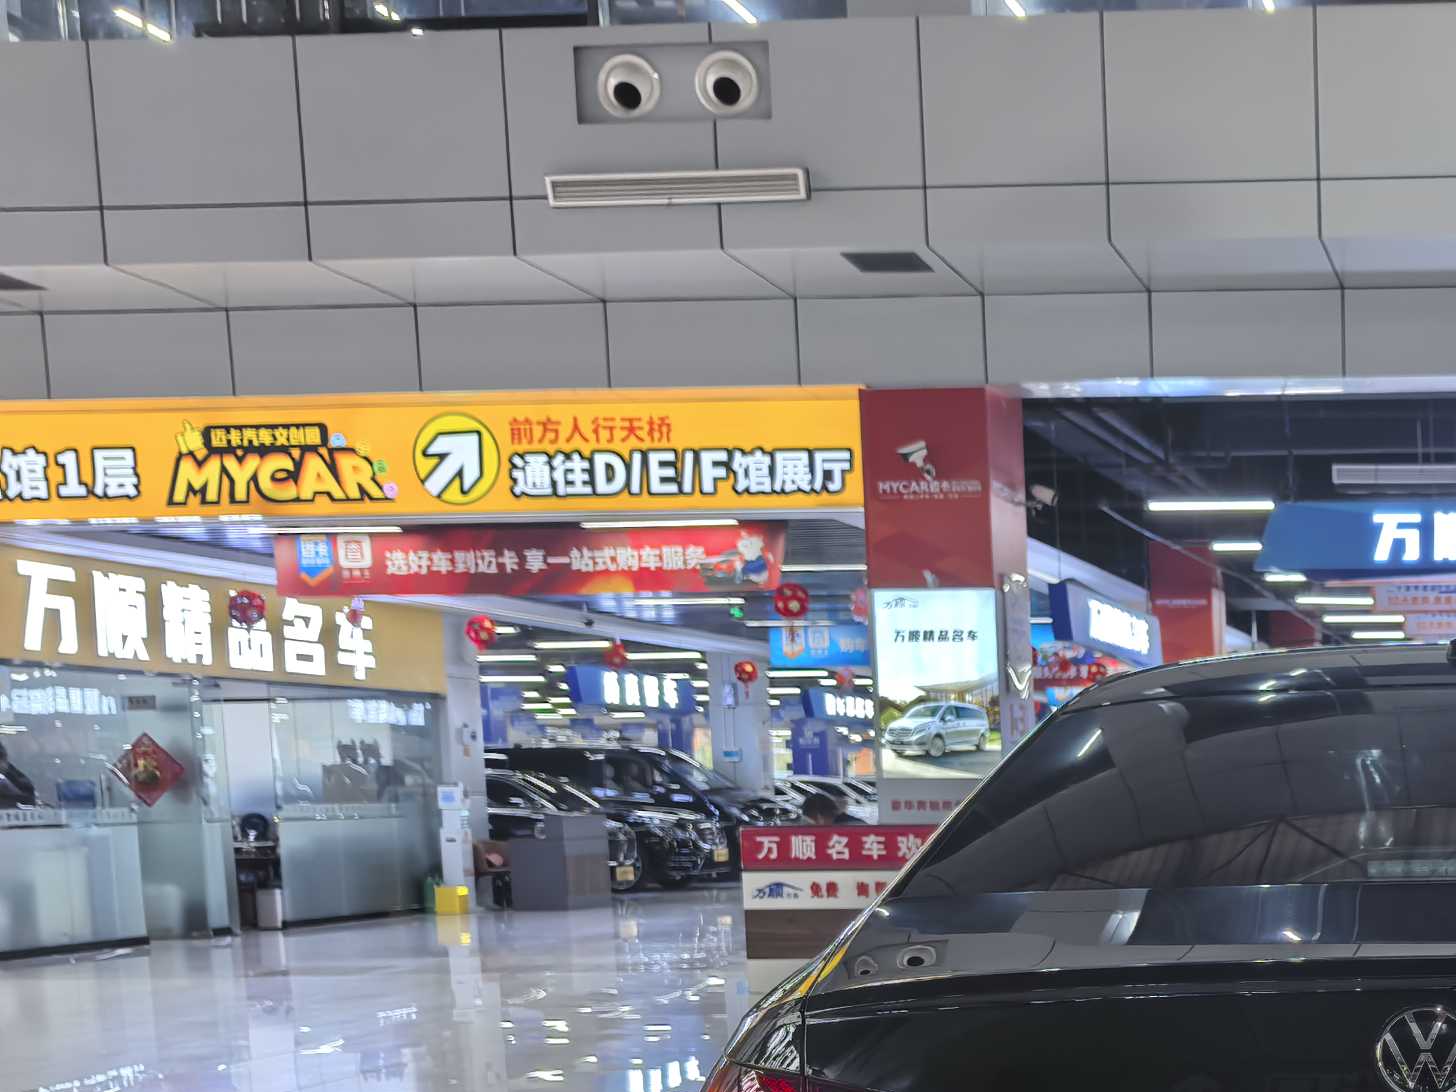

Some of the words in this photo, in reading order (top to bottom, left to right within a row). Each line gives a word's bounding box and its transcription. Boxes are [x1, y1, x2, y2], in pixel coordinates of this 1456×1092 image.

[509, 415, 671, 445] 前方人行天桥
[0, 447, 140, 500] 馆1层
[168, 448, 392, 506] MYCAR
[510, 448, 853, 497] 通往D/E/F馆展厅
[385, 547, 519, 575] 选好车到迈卡
[17, 559, 376, 680] 万顺精品名车
